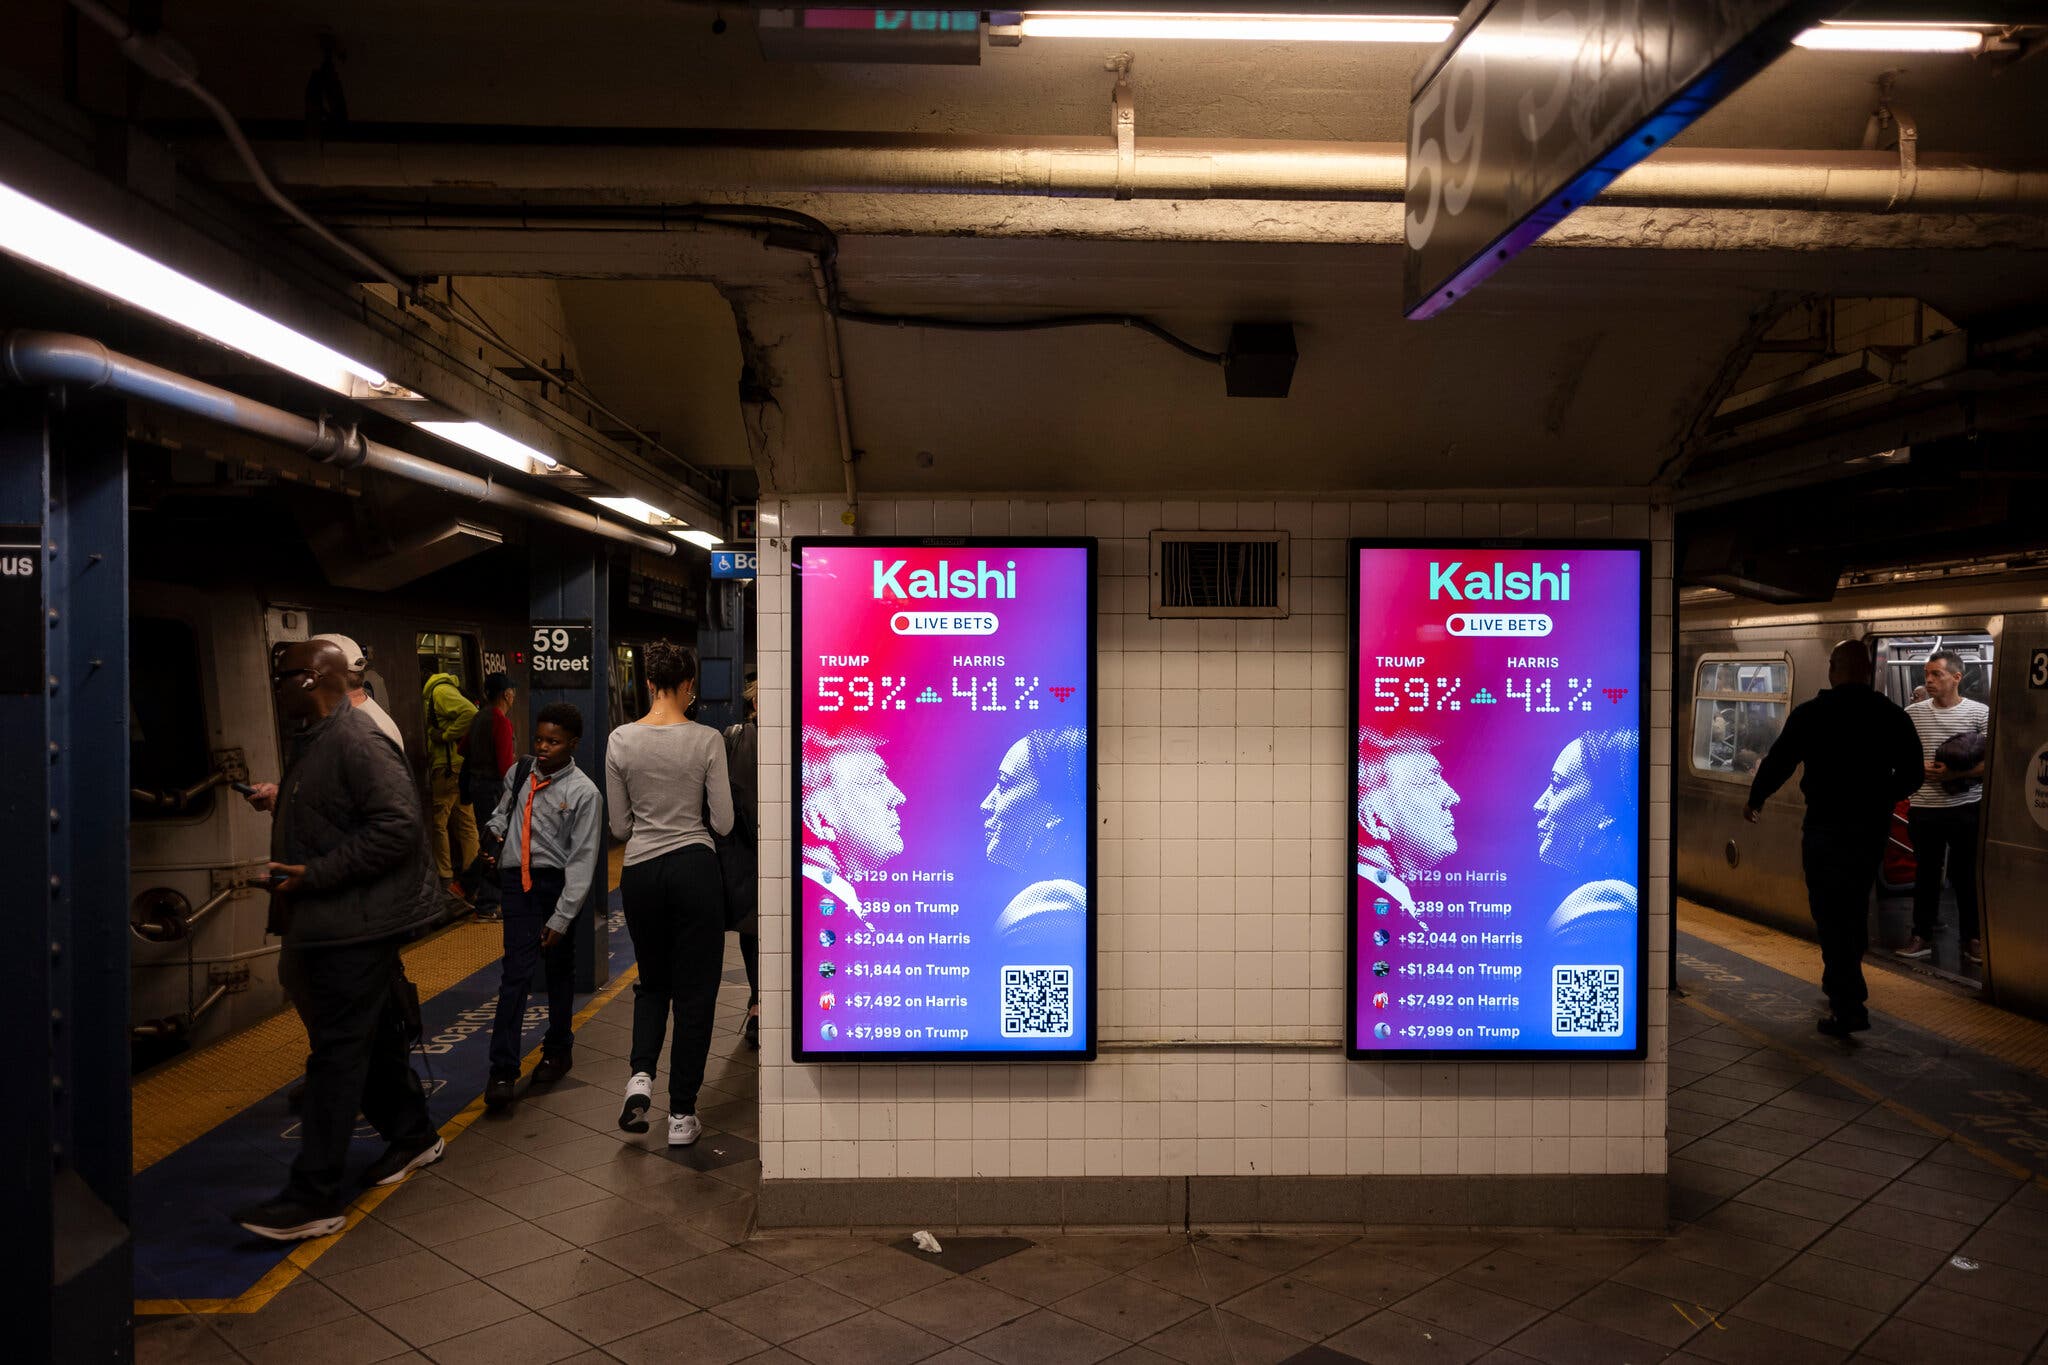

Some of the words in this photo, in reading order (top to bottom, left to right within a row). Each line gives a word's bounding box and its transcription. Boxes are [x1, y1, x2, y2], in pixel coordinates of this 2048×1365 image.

[1405, 45, 1486, 250] 59
[0, 557, 34, 575] us
[873, 560, 1016, 599] Kalshi
[1429, 562, 1570, 600] Kalshi
[915, 617, 948, 630] LIVE
[953, 617, 993, 630] BETS
[1470, 619, 1503, 631] LIVE
[1508, 619, 1547, 631] BETS
[532, 628, 570, 652] 59
[484, 651, 507, 676] 5884
[532, 655, 589, 671] Street
[819, 655, 870, 667] TRUMP
[953, 655, 1005, 667] HARRIS
[1376, 656, 1425, 668] TRUMP
[1507, 657, 1559, 668] HARRIS
[818, 676, 906, 711] 59%
[952, 676, 1039, 711] 41%
[1374, 677, 1461, 712] 59%
[1506, 678, 1592, 712] 41%
[891, 873, 908, 882] on
[912, 870, 954, 882] Harris
[1445, 873, 1462, 882] on
[1465, 870, 1507, 882] Harris
[894, 904, 911, 913] on
[915, 902, 959, 916] Trump
[1447, 904, 1464, 913] on
[1468, 901, 1512, 915] Trump
[845, 932, 904, 946] +$2,044
[908, 935, 925, 945] on
[928, 932, 971, 945] Harris
[1398, 932, 1457, 946] +$2,044
[1460, 935, 1478, 945] on
[1481, 932, 1523, 945] Harris
[845, 964, 901, 978] +$1,844
[904, 967, 922, 976] on
[925, 964, 970, 978] Trump
[1398, 963, 1454, 977] +$1,844
[1457, 966, 1475, 975] on
[1478, 964, 1522, 978] Trump
[845, 995, 901, 1009] +$7,492
[904, 998, 922, 1007] on
[925, 995, 968, 1007] Harris
[1398, 995, 1454, 1008] +$7,492
[1457, 998, 1475, 1007] on
[1478, 995, 1520, 1007] Harris
[408, 995, 499, 1055] Boardin
[846, 1026, 901, 1041] +$7,999
[904, 1030, 922, 1039] on
[925, 1027, 969, 1042] Trump
[1399, 1025, 1454, 1040] +$7,999
[1457, 1029, 1474, 1038] on
[1477, 1026, 1520, 1041] Trump
